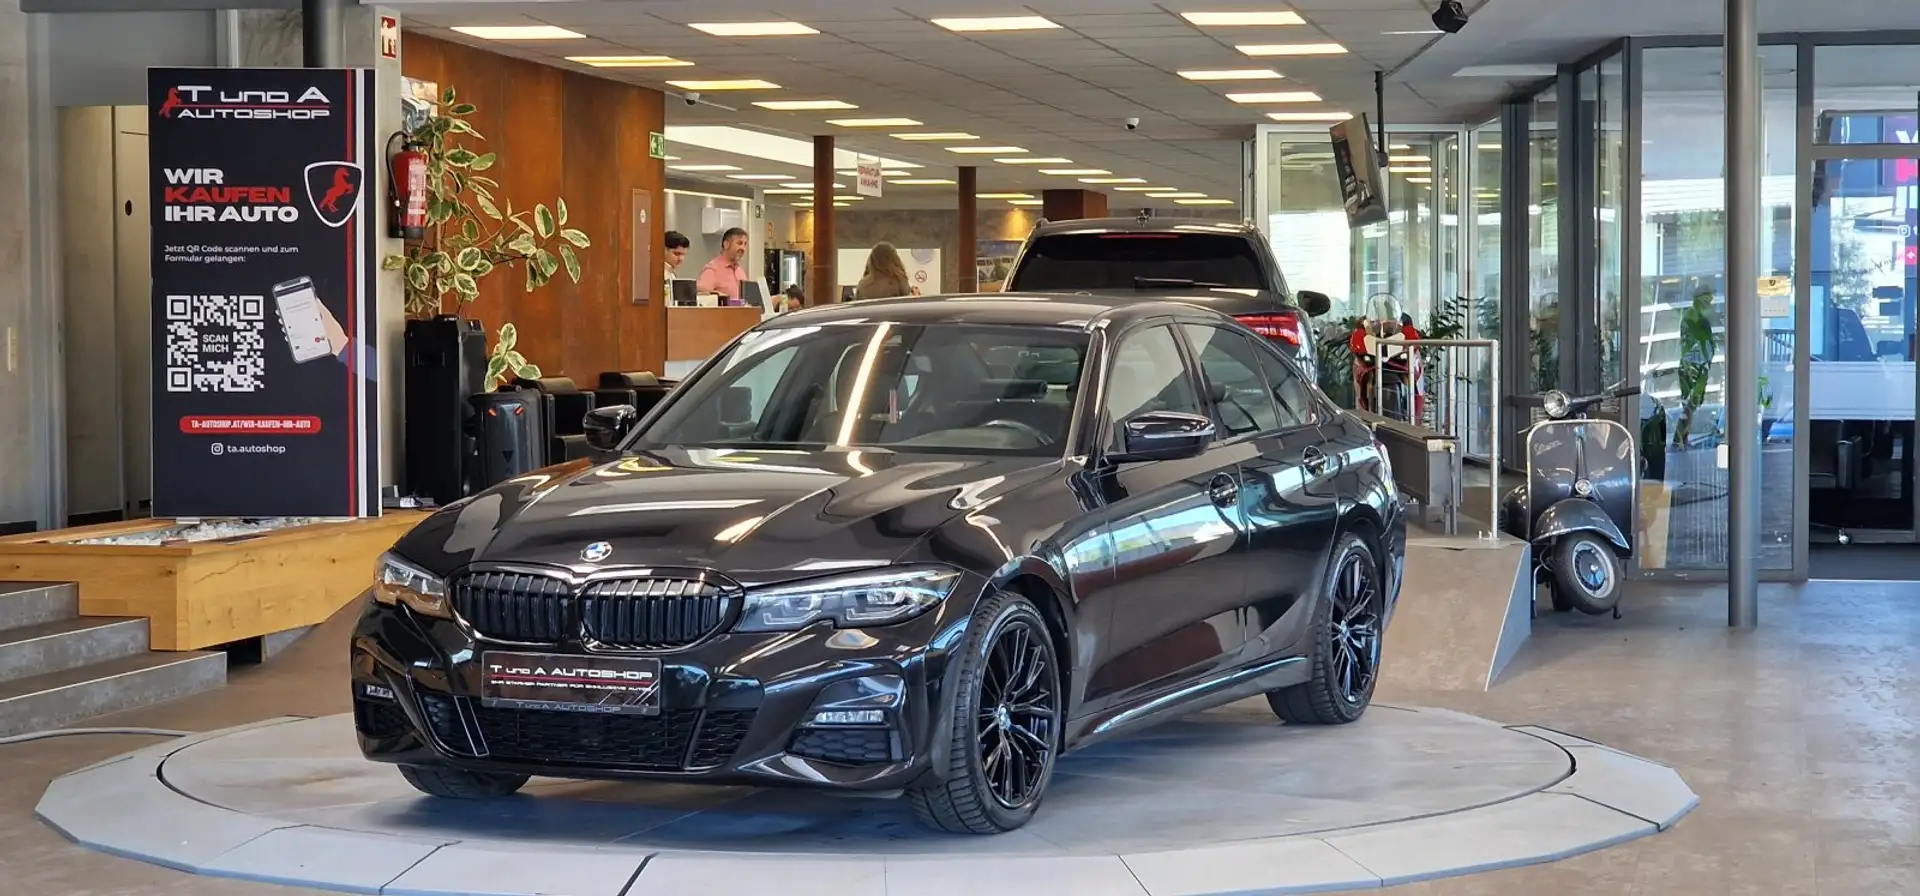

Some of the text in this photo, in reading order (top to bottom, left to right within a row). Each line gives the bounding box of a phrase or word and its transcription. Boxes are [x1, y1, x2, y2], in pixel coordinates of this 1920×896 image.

[177, 85, 212, 102] T
[296, 86, 330, 104] A
[177, 108, 330, 120] AUTOSHOP
[164, 168, 224, 185] WIR
[164, 186, 290, 203] KAUFEN
[164, 205, 299, 223] IHR AUTO
[164, 244, 299, 254] Jetzt QR Code scannen und zum
[164, 254, 246, 264] Formular gelangen:
[202, 333, 229, 343] SCAN
[202, 343, 229, 353] MICH
[226, 444, 286, 455] ta.autoshop
[489, 664, 503, 673] T
[534, 666, 546, 675] A
[551, 667, 653, 680] AUTOSHOP
[554, 704, 622, 714] AUTOSHOP
